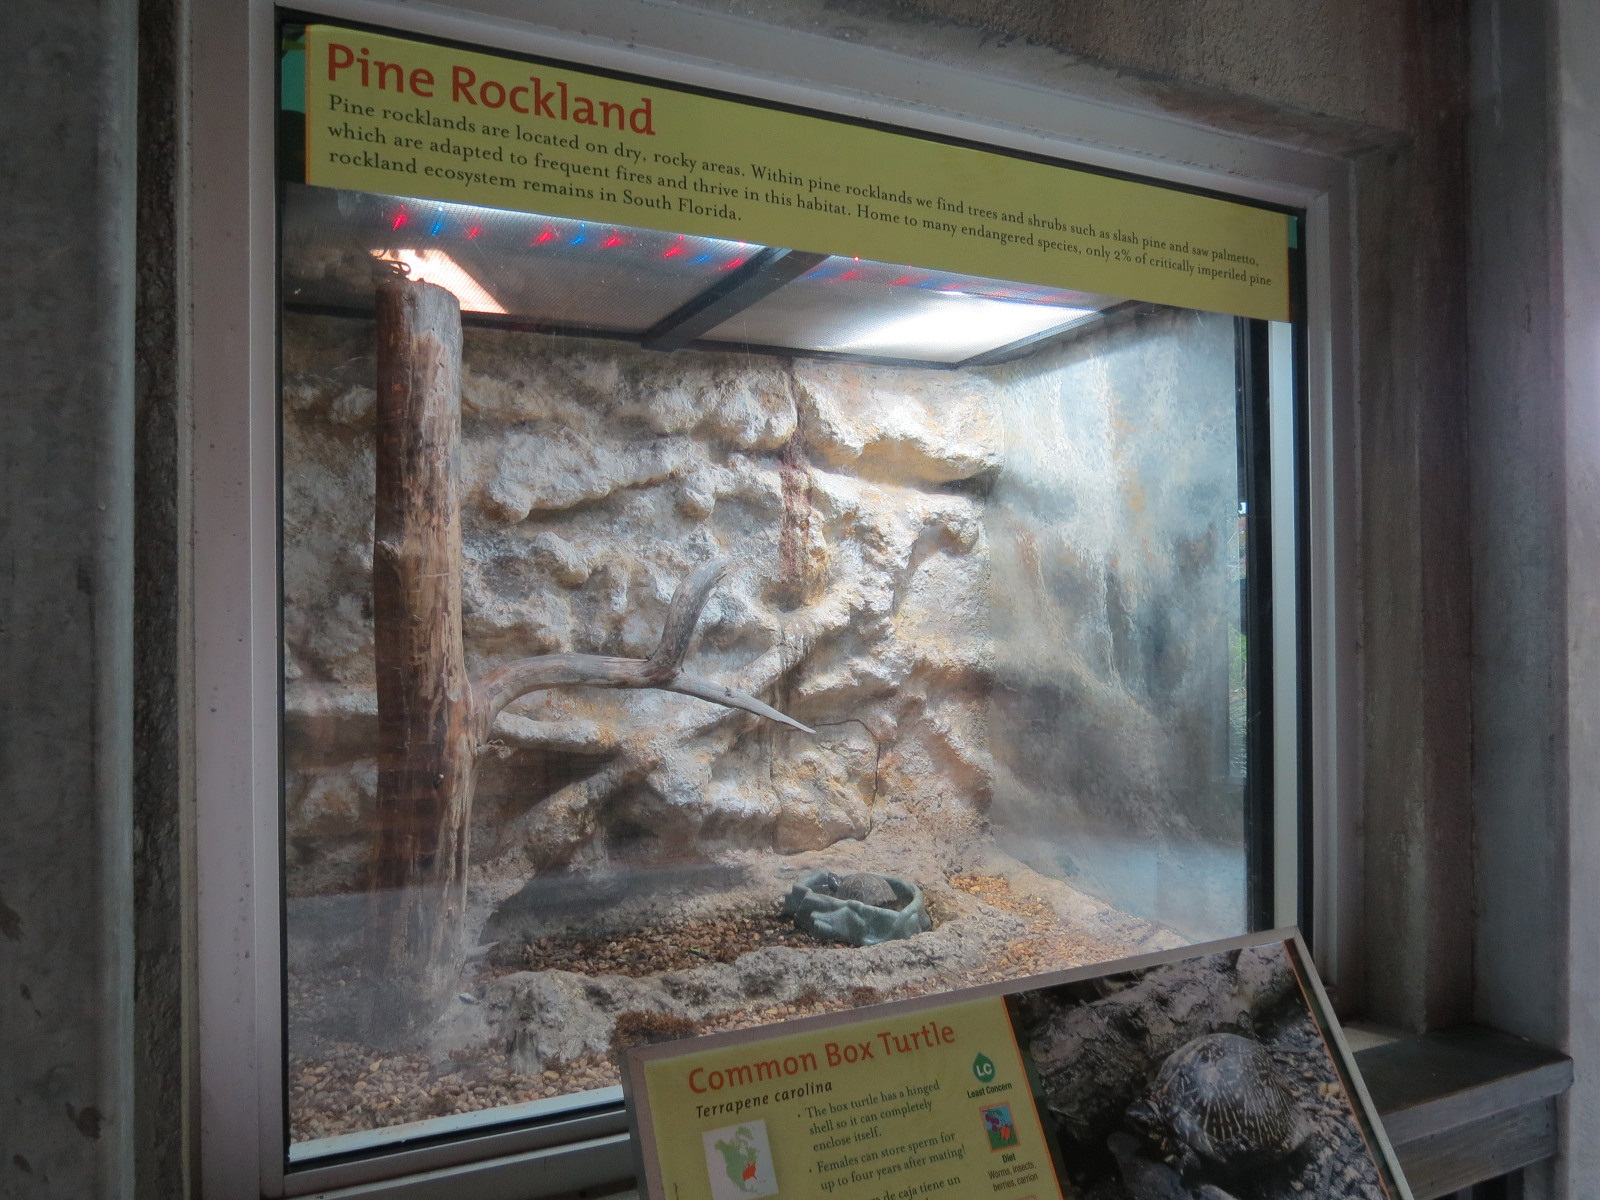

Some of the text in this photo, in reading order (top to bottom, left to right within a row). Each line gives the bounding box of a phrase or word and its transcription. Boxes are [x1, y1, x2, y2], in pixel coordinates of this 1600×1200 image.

[328, 43, 655, 135] Pine Rockland
[330, 94, 1258, 266] Pine rocklands are located on dry, rocky areas. Within pine rocklands we find trees and shrubs such as slash pine and saw palmetto,
[330, 151, 741, 221] rockland ecosystem remains in South Florida.
[328, 122, 1271, 286] which are adapted to frequent fires and thrive in this habitat. Home to many endangered species, only 2% of critically imperiled pine
[688, 1022, 956, 1094] Common Box Turtle
[976, 1062, 992, 1076] LC
[695, 1081, 833, 1119] Terrapene carolina
[805, 1106, 827, 1119] The
[829, 1102, 849, 1114] box
[851, 1093, 878, 1109] turtle
[880, 1090, 898, 1102] has
[906, 1080, 940, 1097] hinged
[967, 1082, 1013, 1099] Least Concern
[809, 1100, 932, 1135] shell so it can completely
[813, 1126, 882, 1152] enclose itself.
[817, 1130, 956, 1174] Females can store sperm for
[1001, 1152, 1017, 1164] Diet
[820, 1144, 966, 1193] up to four years after mating!
[883, 1190, 896, 1200] de
[898, 1185, 918, 1200] caja
[919, 1181, 945, 1194] tiene
[947, 1175, 961, 1186] un
[987, 1161, 1037, 1180] Worms, insects,
[992, 1173, 1039, 1192] berries, carrion
